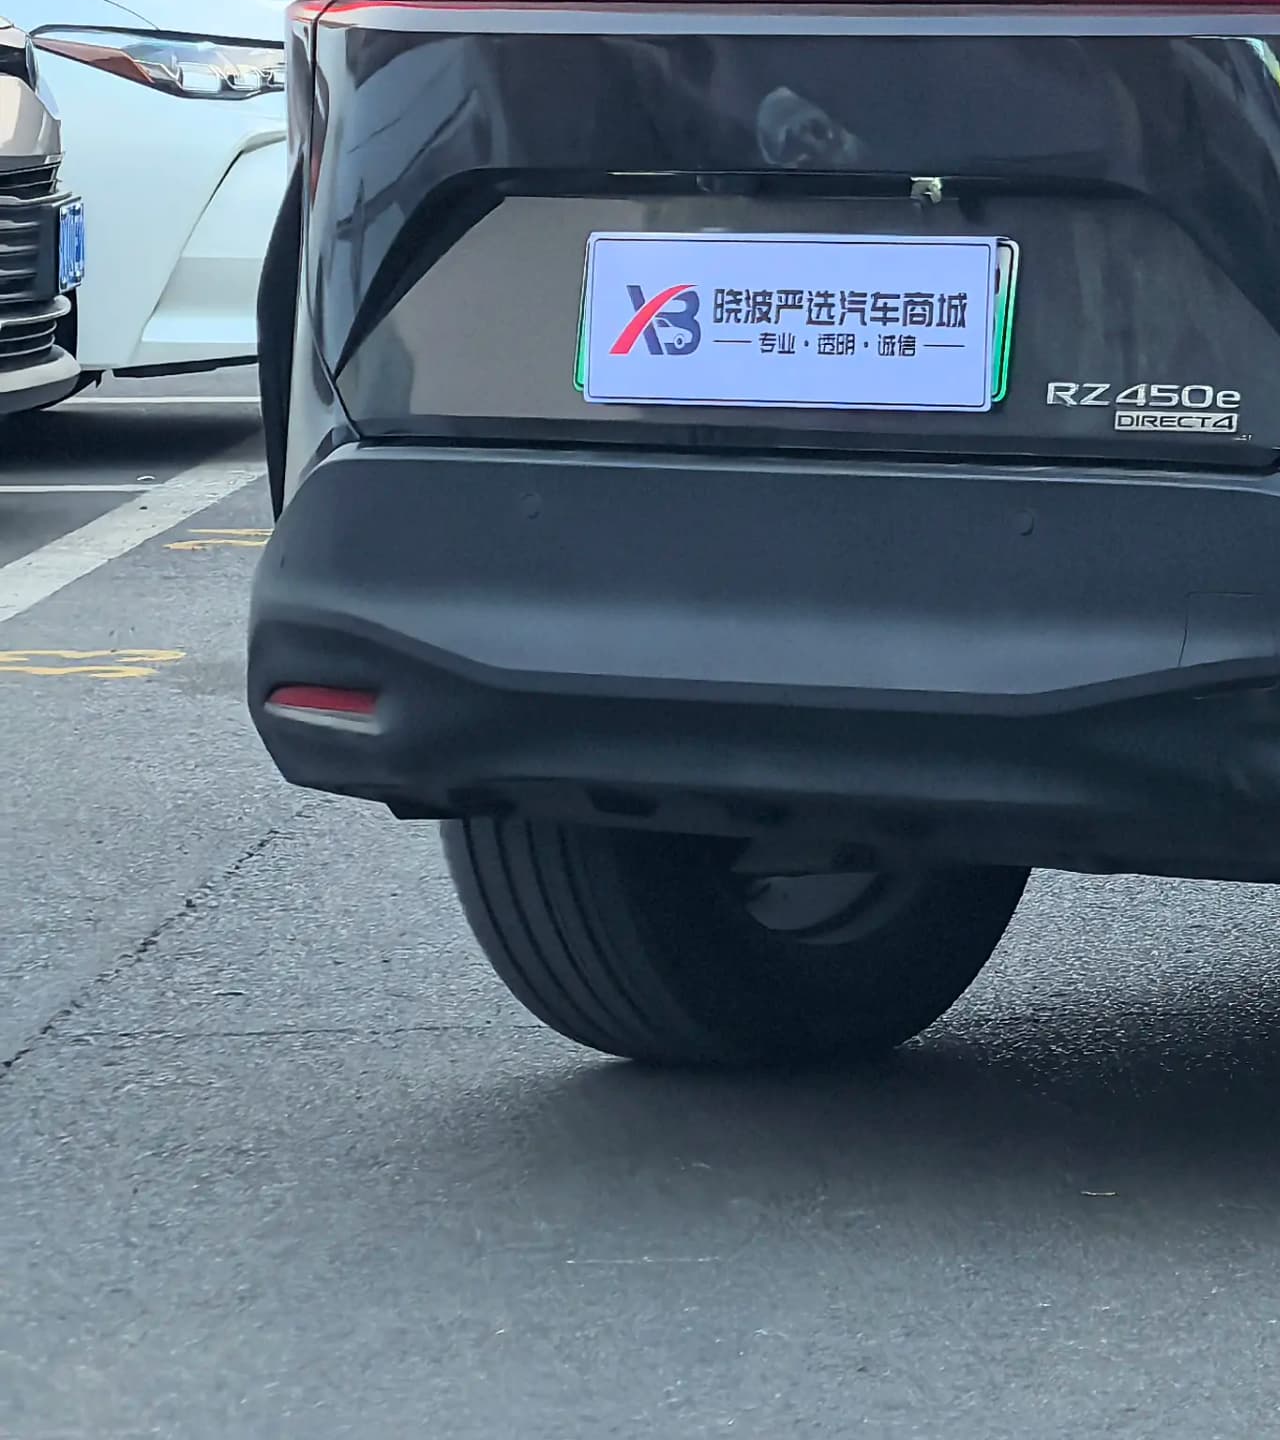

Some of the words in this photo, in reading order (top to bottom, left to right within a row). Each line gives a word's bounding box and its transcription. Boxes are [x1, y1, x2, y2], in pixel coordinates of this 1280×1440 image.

[712, 288, 969, 329] 晓波严选汽车商城
